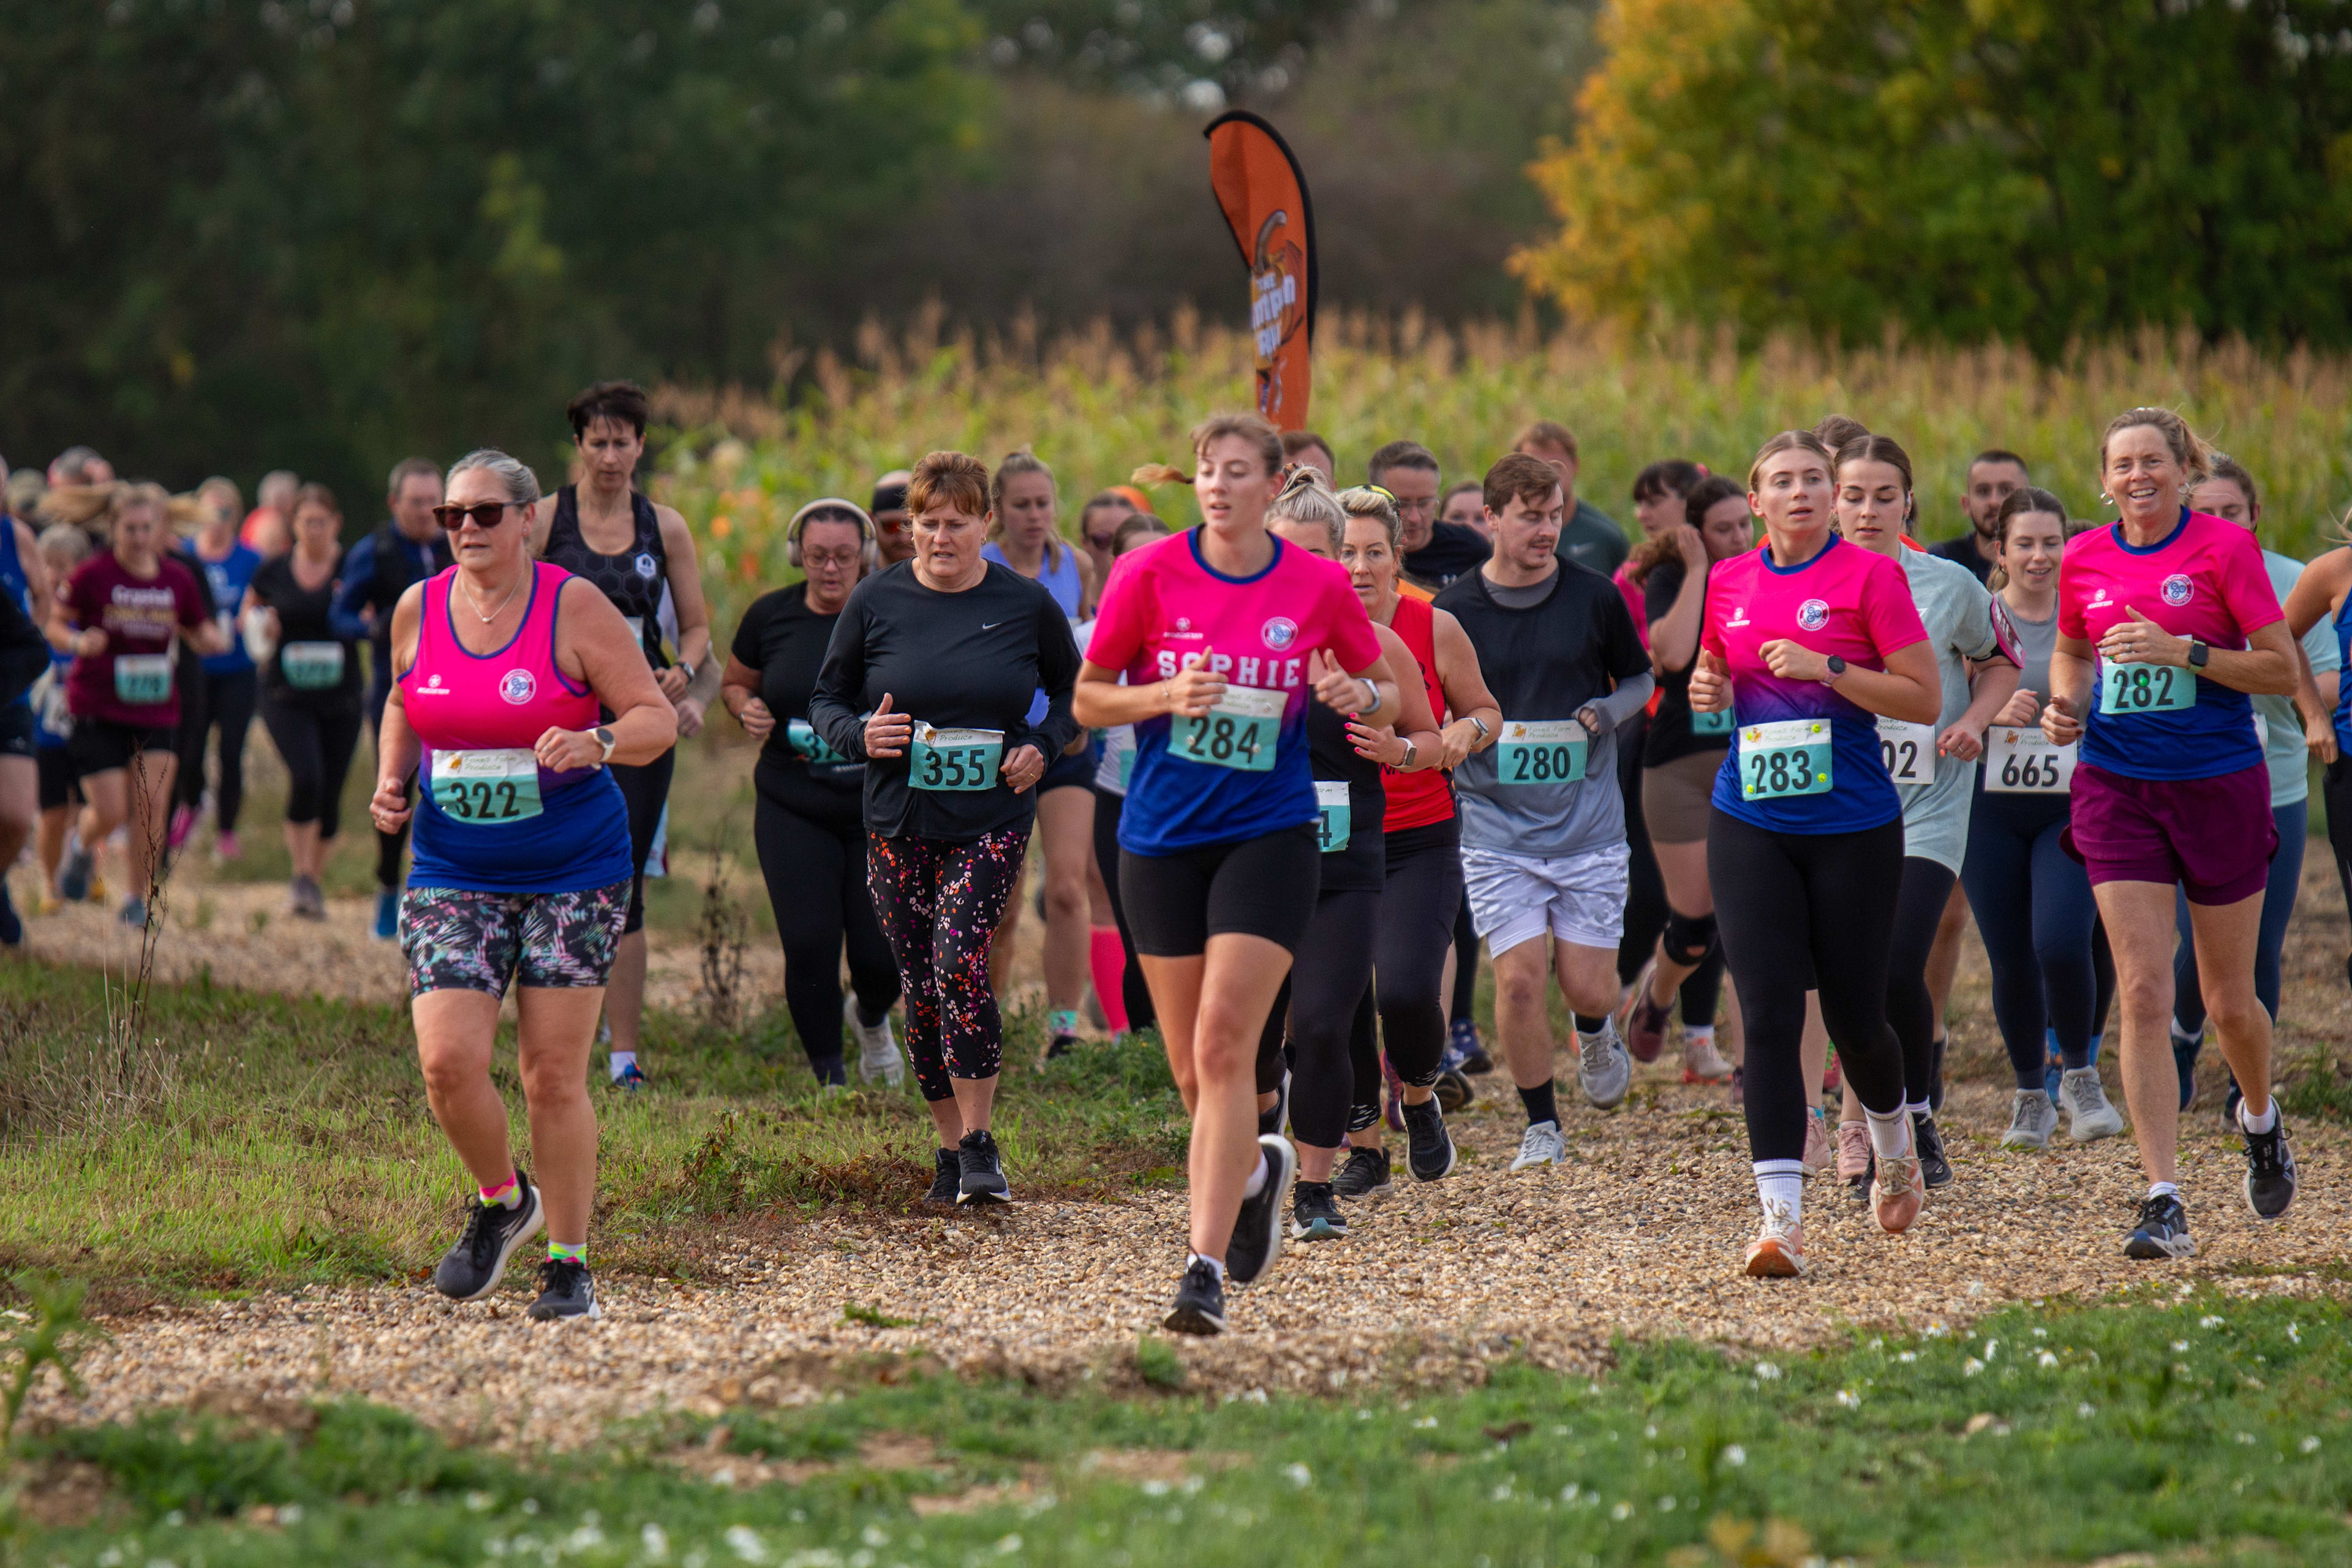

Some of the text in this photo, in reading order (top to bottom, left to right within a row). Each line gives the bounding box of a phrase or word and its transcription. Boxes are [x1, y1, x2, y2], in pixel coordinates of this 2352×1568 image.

[2114, 667, 2174, 709] 282
[1188, 715, 1259, 764] 284
[923, 748, 985, 786] 355
[1513, 746, 1571, 780] 280
[1752, 750, 1813, 794] 283
[2002, 753, 2060, 788] 665
[450, 782, 520, 818] 322
